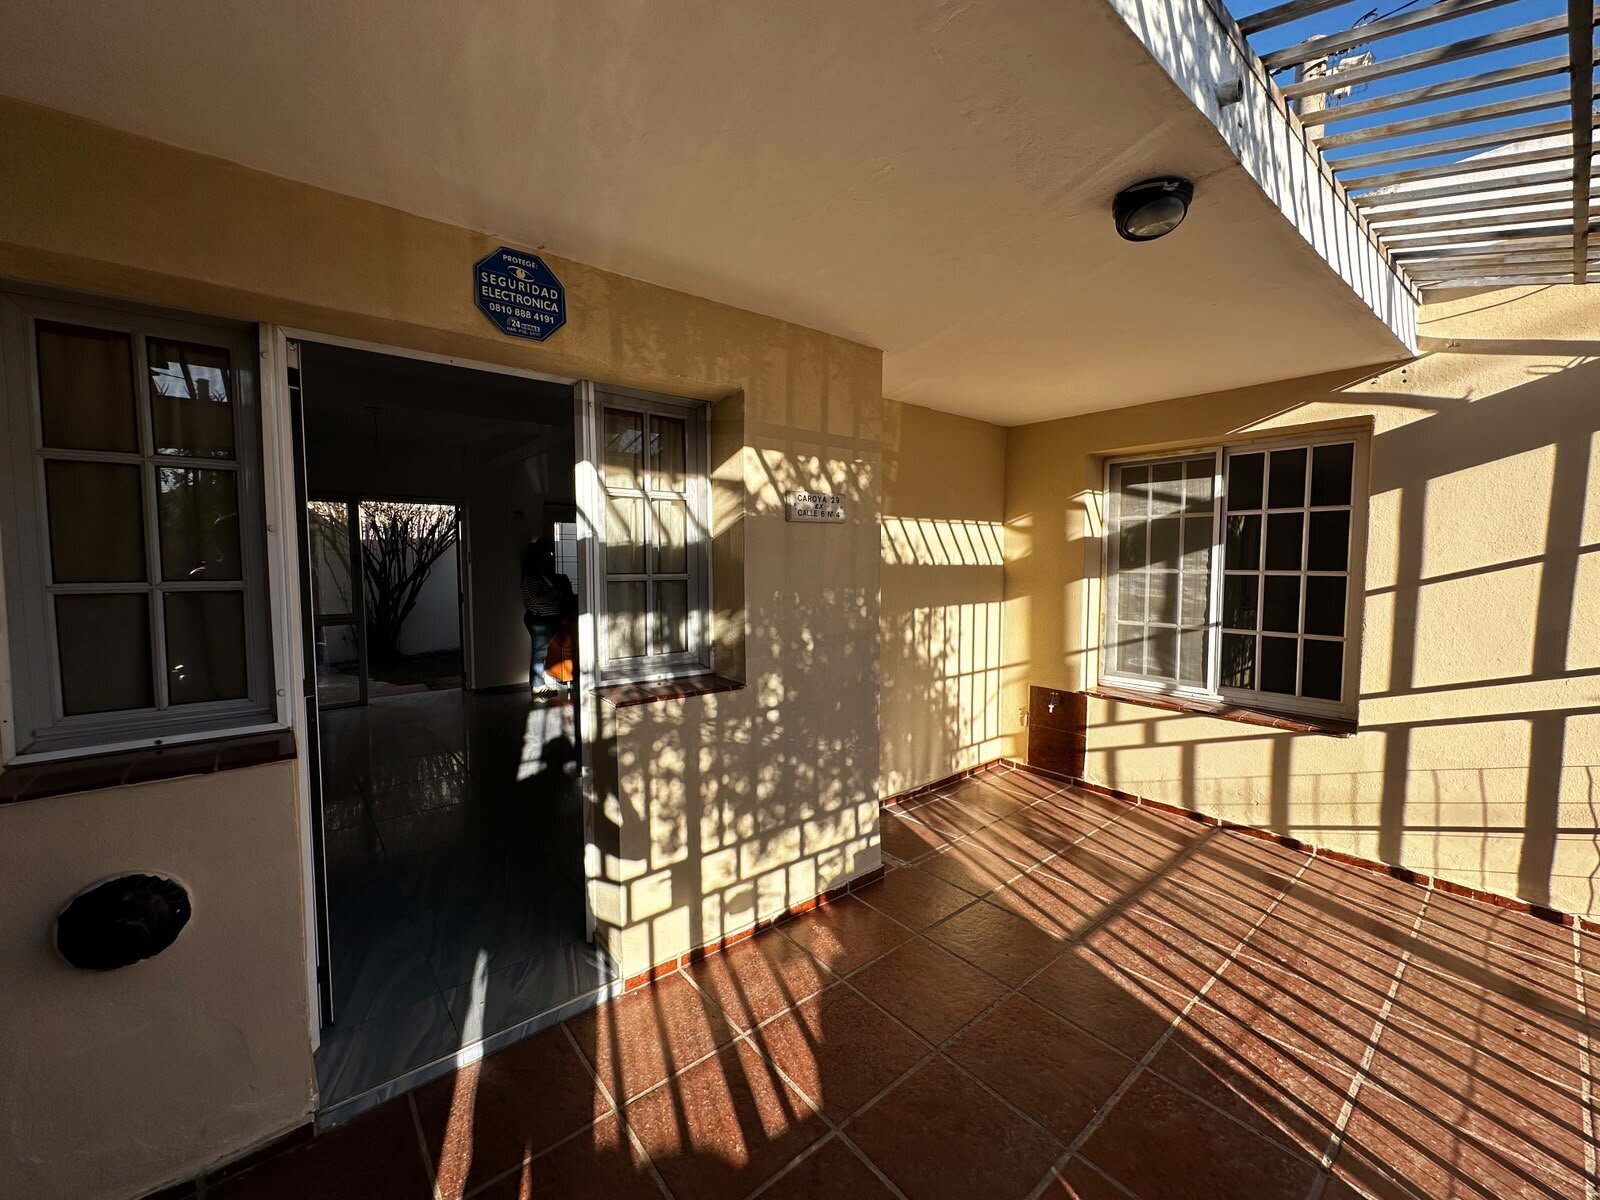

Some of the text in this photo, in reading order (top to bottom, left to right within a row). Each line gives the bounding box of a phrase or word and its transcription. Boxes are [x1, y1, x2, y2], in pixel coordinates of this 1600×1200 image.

[481, 272, 558, 299] SEGURIDAD
[481, 285, 559, 313] ELECTRONICA
[489, 302, 554, 324] 0810 888 4191
[511, 319, 520, 328] 24
[797, 494, 840, 504] CAROYA 29
[797, 509, 818, 517] CALLE
[820, 510, 825, 518] 6
